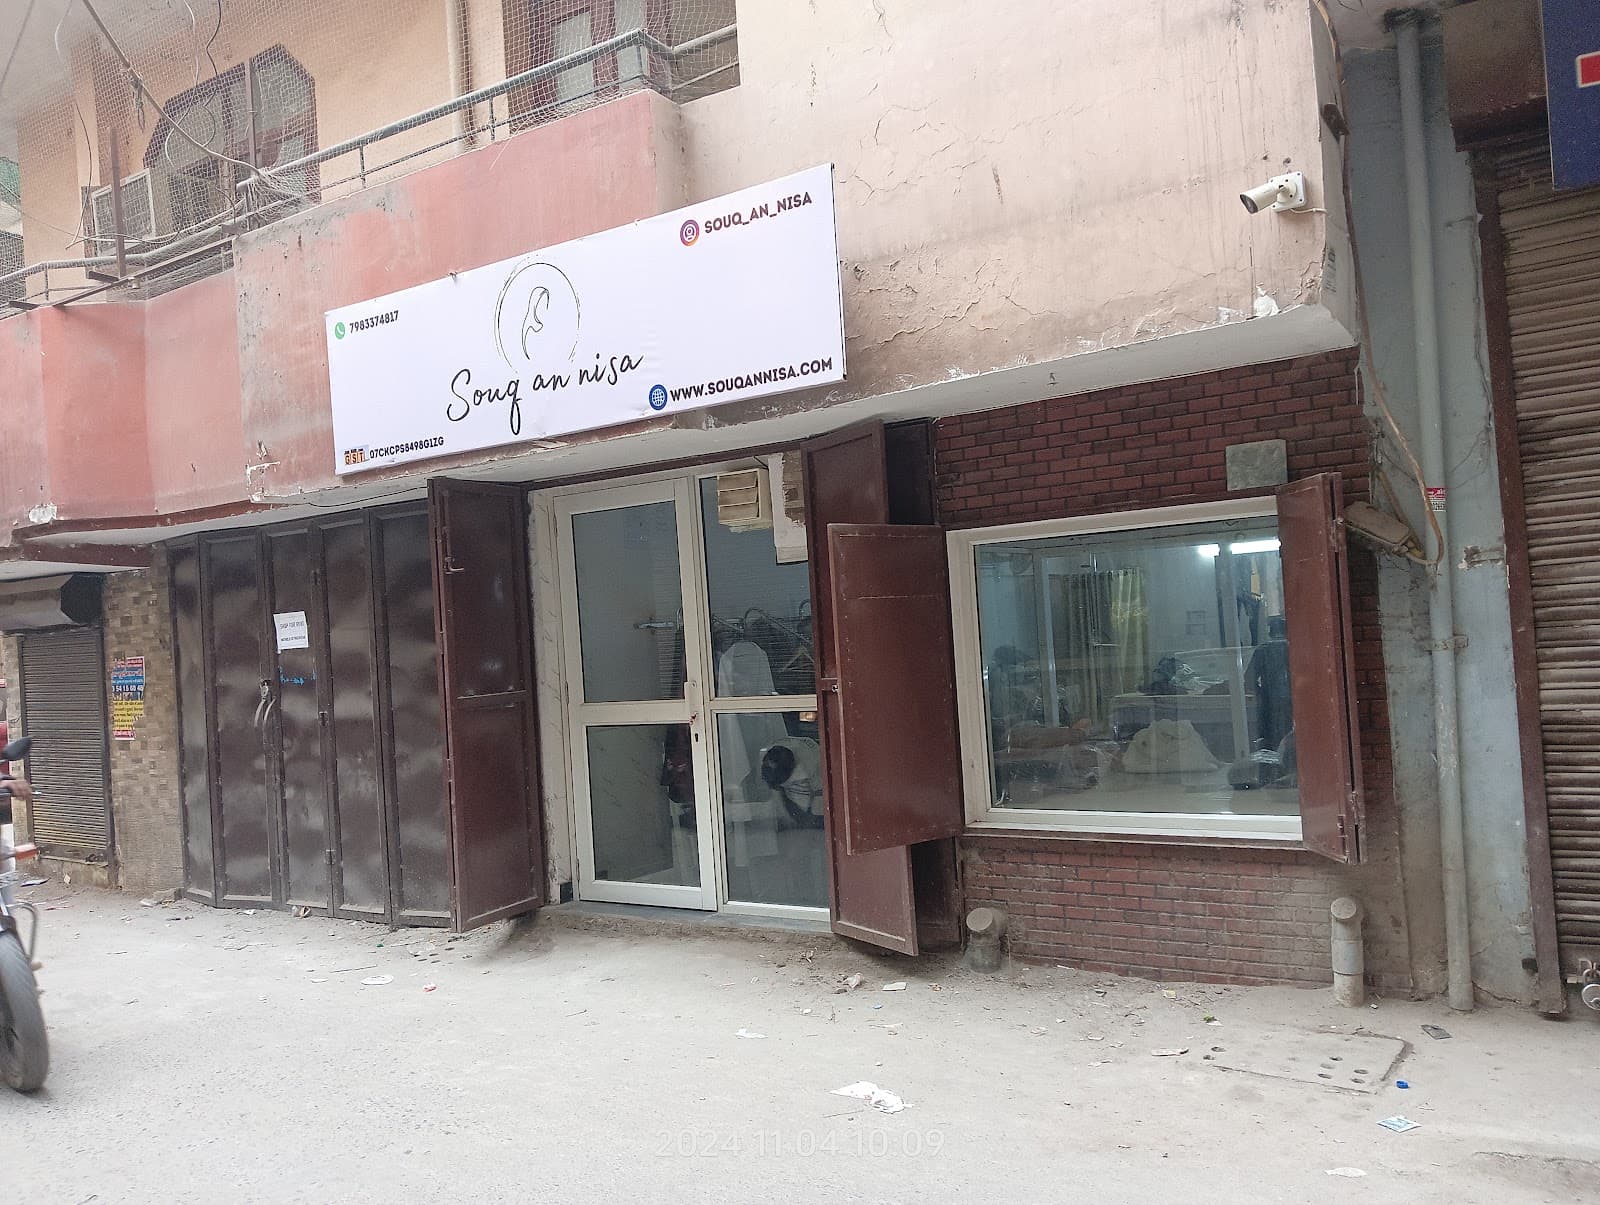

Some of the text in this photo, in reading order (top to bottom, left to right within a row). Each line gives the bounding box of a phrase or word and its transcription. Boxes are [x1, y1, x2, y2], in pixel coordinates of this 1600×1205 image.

[704, 191, 812, 234] SOUQ_AN_NISA
[349, 310, 399, 333] 7983374817
[447, 353, 644, 435] Souq an nisa
[670, 357, 833, 402] WWW.SOUQANNISA.COM
